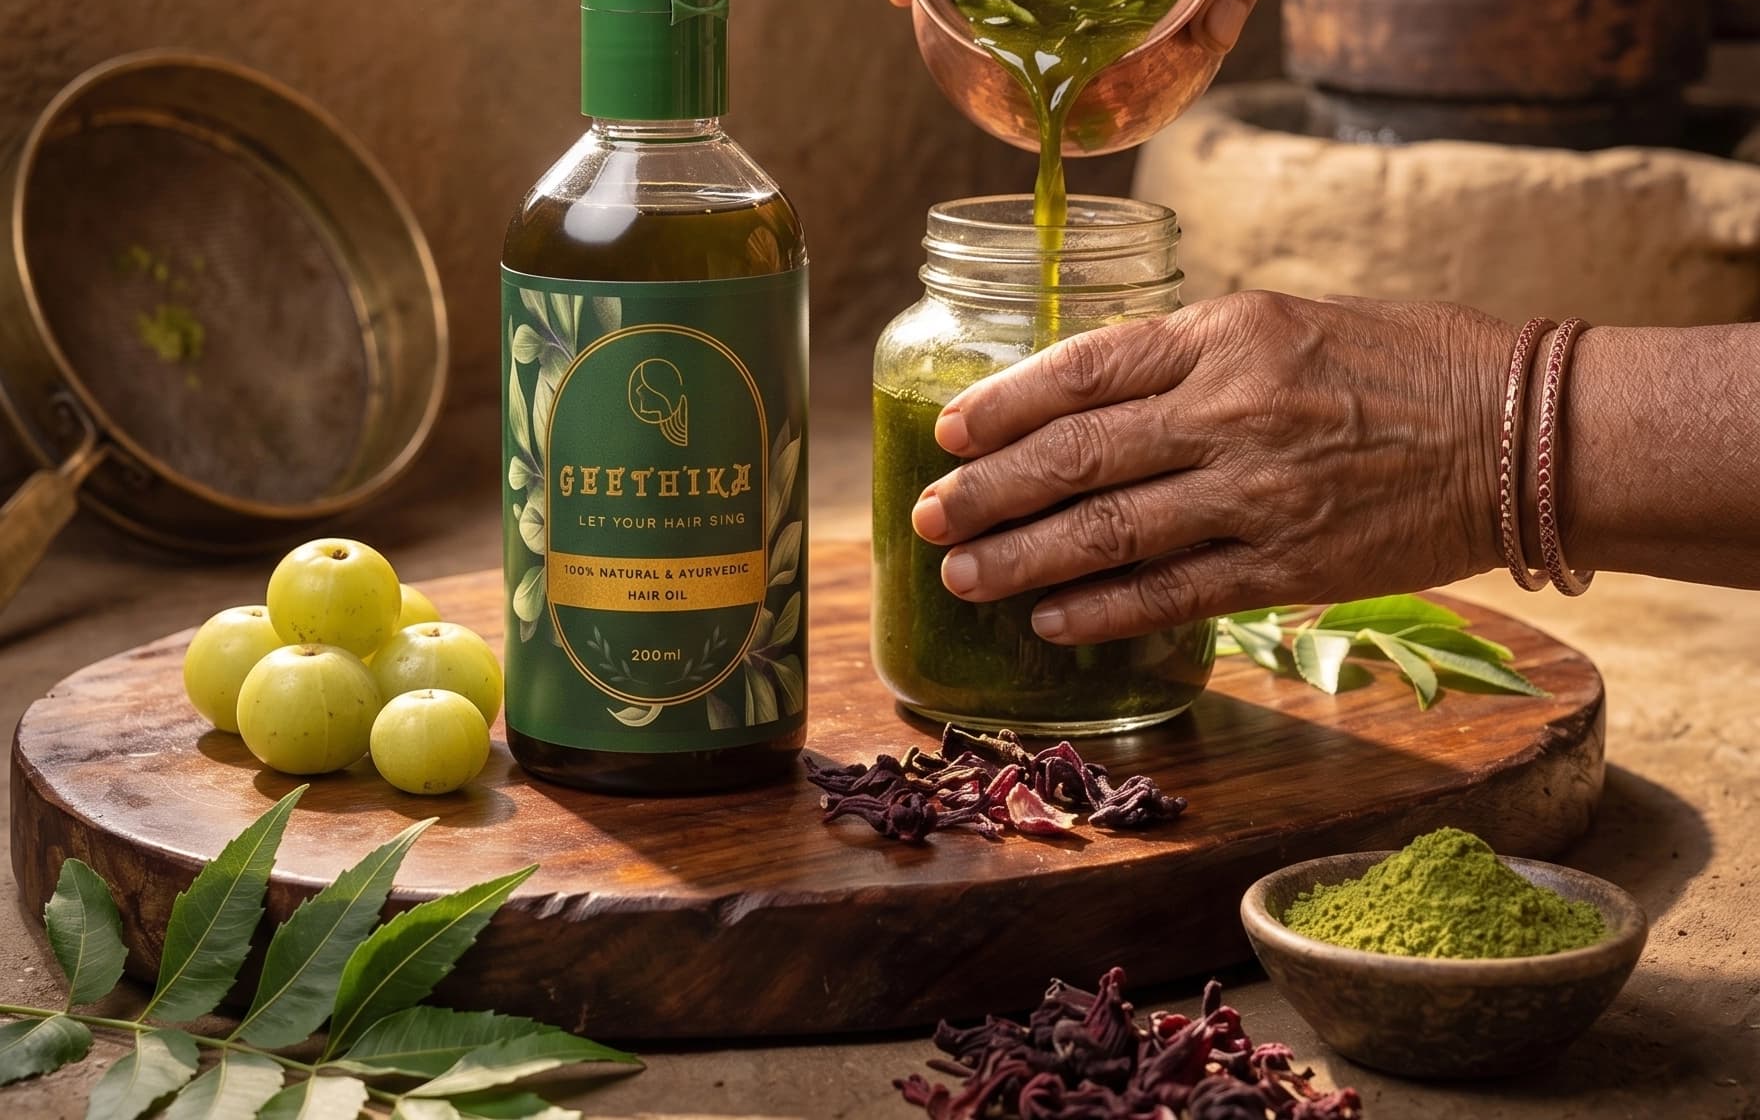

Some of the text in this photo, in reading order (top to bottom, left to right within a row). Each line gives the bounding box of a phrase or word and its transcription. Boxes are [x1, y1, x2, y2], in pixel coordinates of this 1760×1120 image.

[560, 463, 751, 497] GEETHIKA
[578, 513, 746, 529] LET YOUR HAIR SING
[564, 563, 749, 580] 100% NATURAL & AYURVEDIC
[628, 590, 688, 601] HAIR OIL
[631, 648, 681, 662] 200ml
